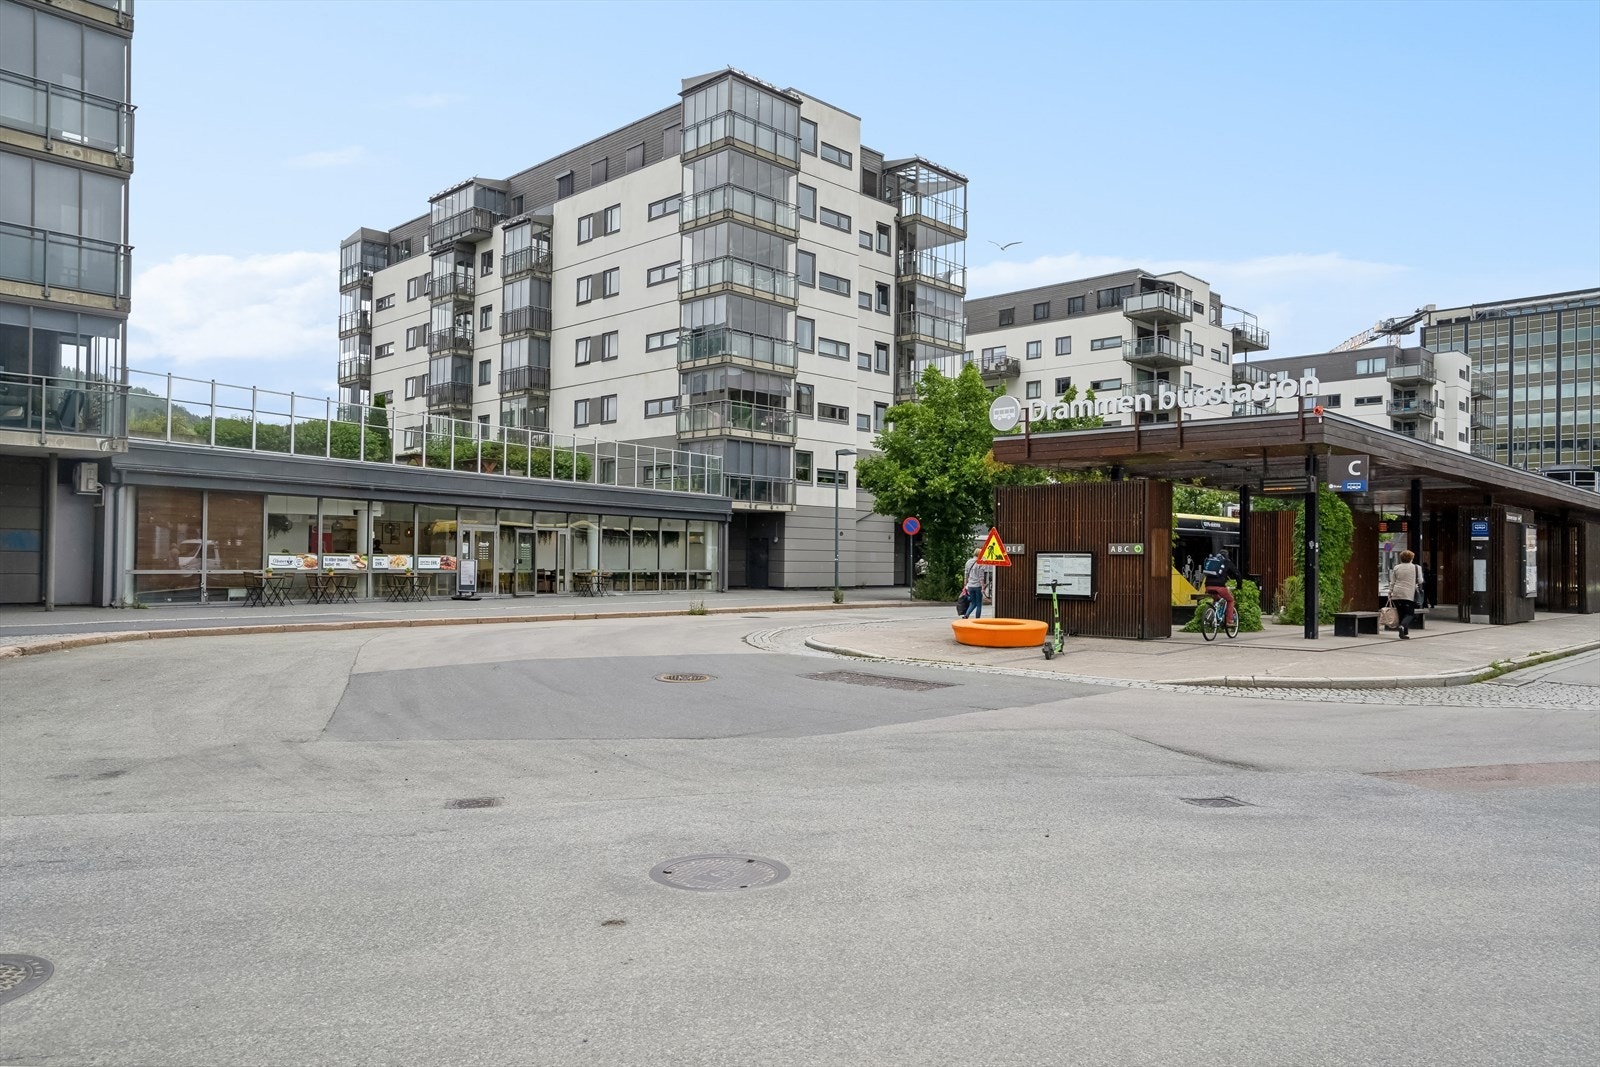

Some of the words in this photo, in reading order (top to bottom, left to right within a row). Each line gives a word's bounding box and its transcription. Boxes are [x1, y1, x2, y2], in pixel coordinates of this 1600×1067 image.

[1028, 393, 1152, 422] Drammen
[1158, 373, 1320, 410] busstasjon
[1348, 460, 1361, 476] C
